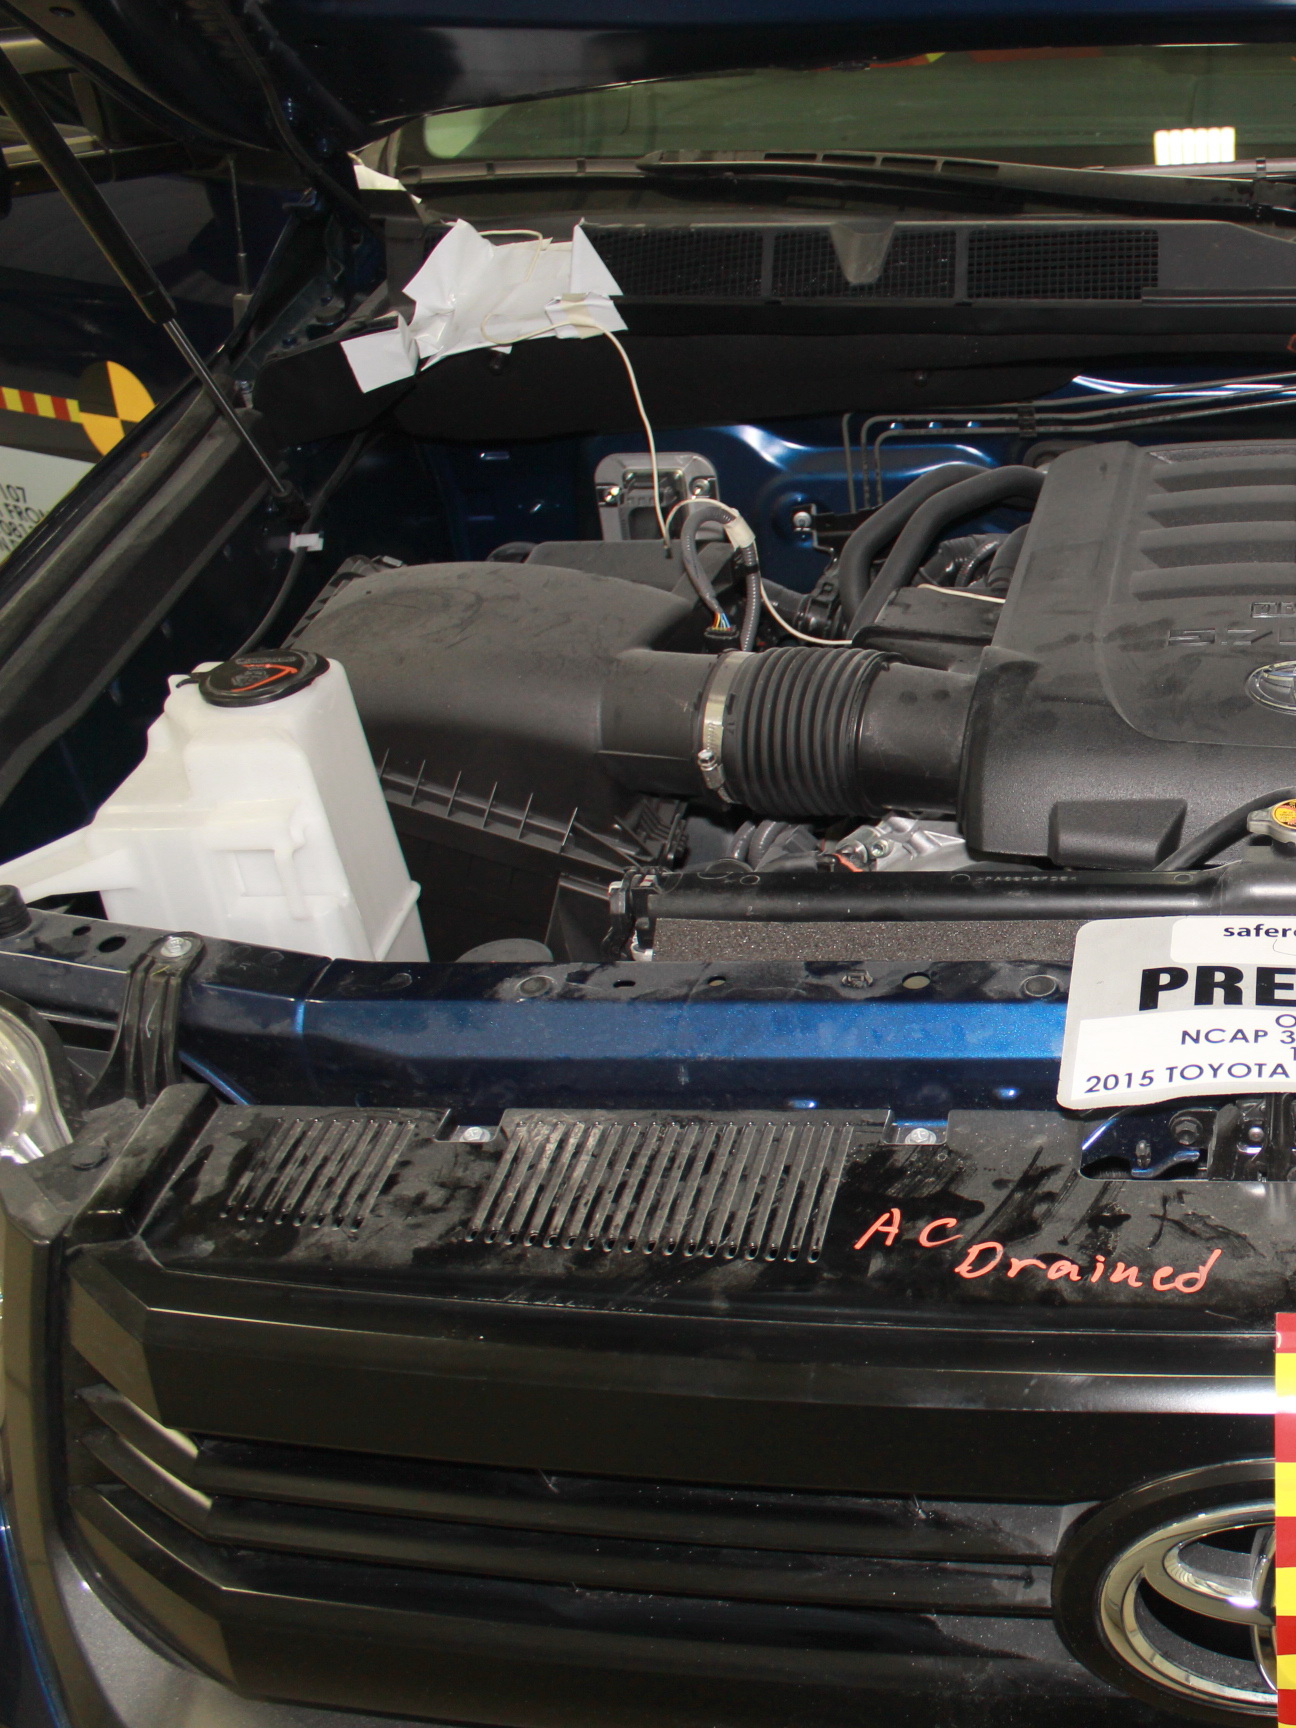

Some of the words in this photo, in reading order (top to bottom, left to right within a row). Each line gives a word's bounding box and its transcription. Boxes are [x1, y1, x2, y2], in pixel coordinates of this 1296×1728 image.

[1180, 1028, 1269, 1047] NCAP
[1084, 1069, 1155, 1095] 2015
[1165, 1063, 1290, 1084] TOYOTA
[953, 1240, 1223, 1294] Drained
